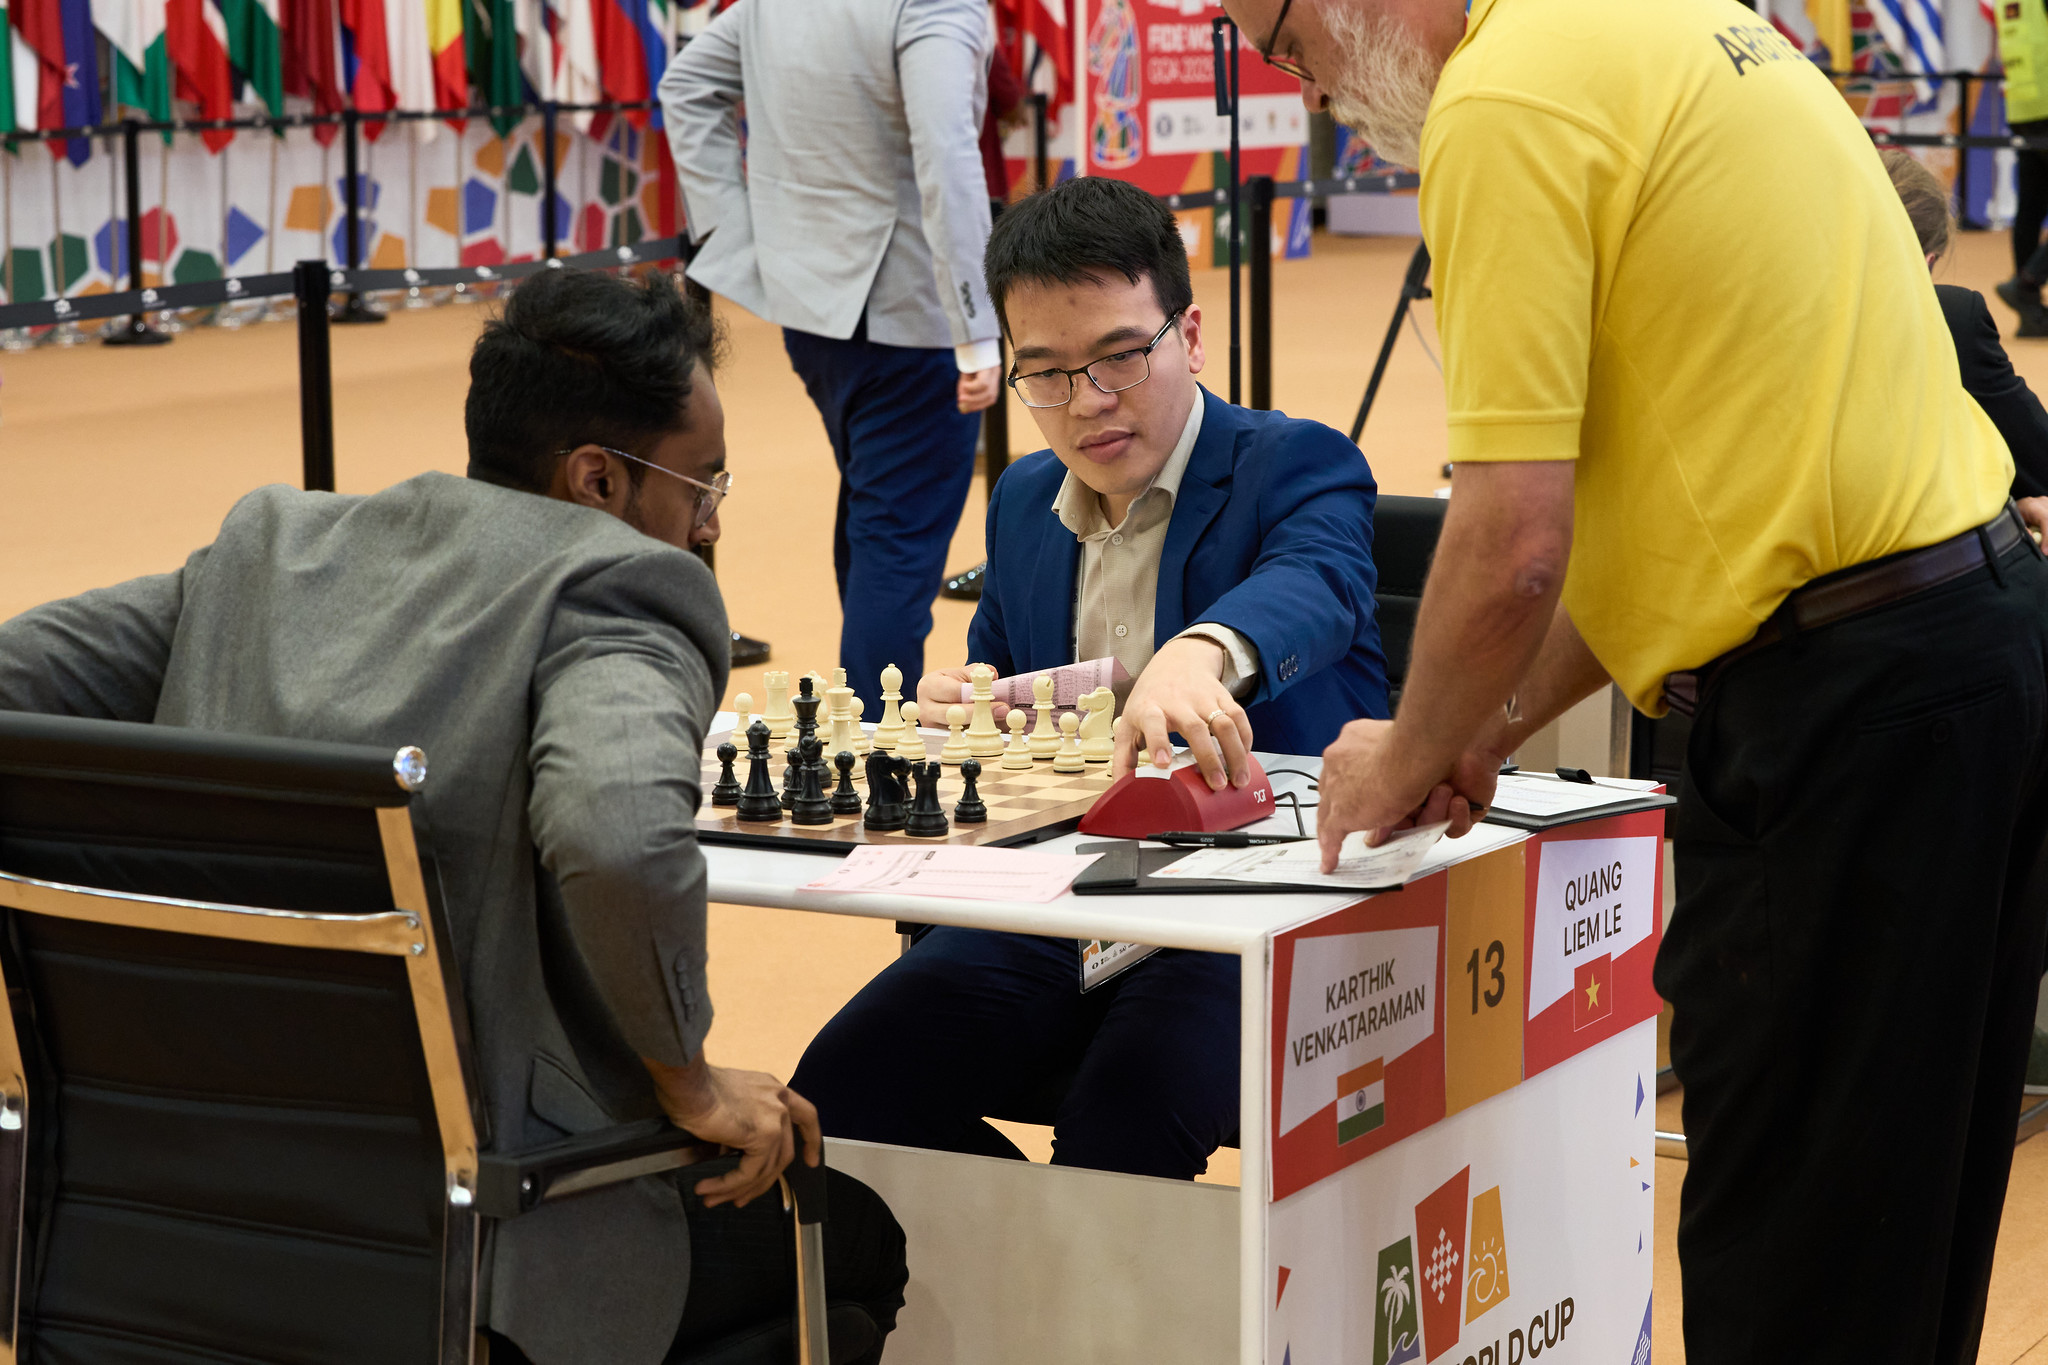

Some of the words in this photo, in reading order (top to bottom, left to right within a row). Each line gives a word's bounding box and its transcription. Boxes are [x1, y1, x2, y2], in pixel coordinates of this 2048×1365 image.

[1565, 861, 1622, 911] QUANG
[1564, 912, 1600, 957] LIEM
[1604, 903, 1622, 938] LE
[1326, 958, 1395, 1014] KARTHIK
[1466, 940, 1505, 1016] 13
[1293, 984, 1425, 1067] VENKATARAMAN
[1527, 1297, 1574, 1359] CUP
